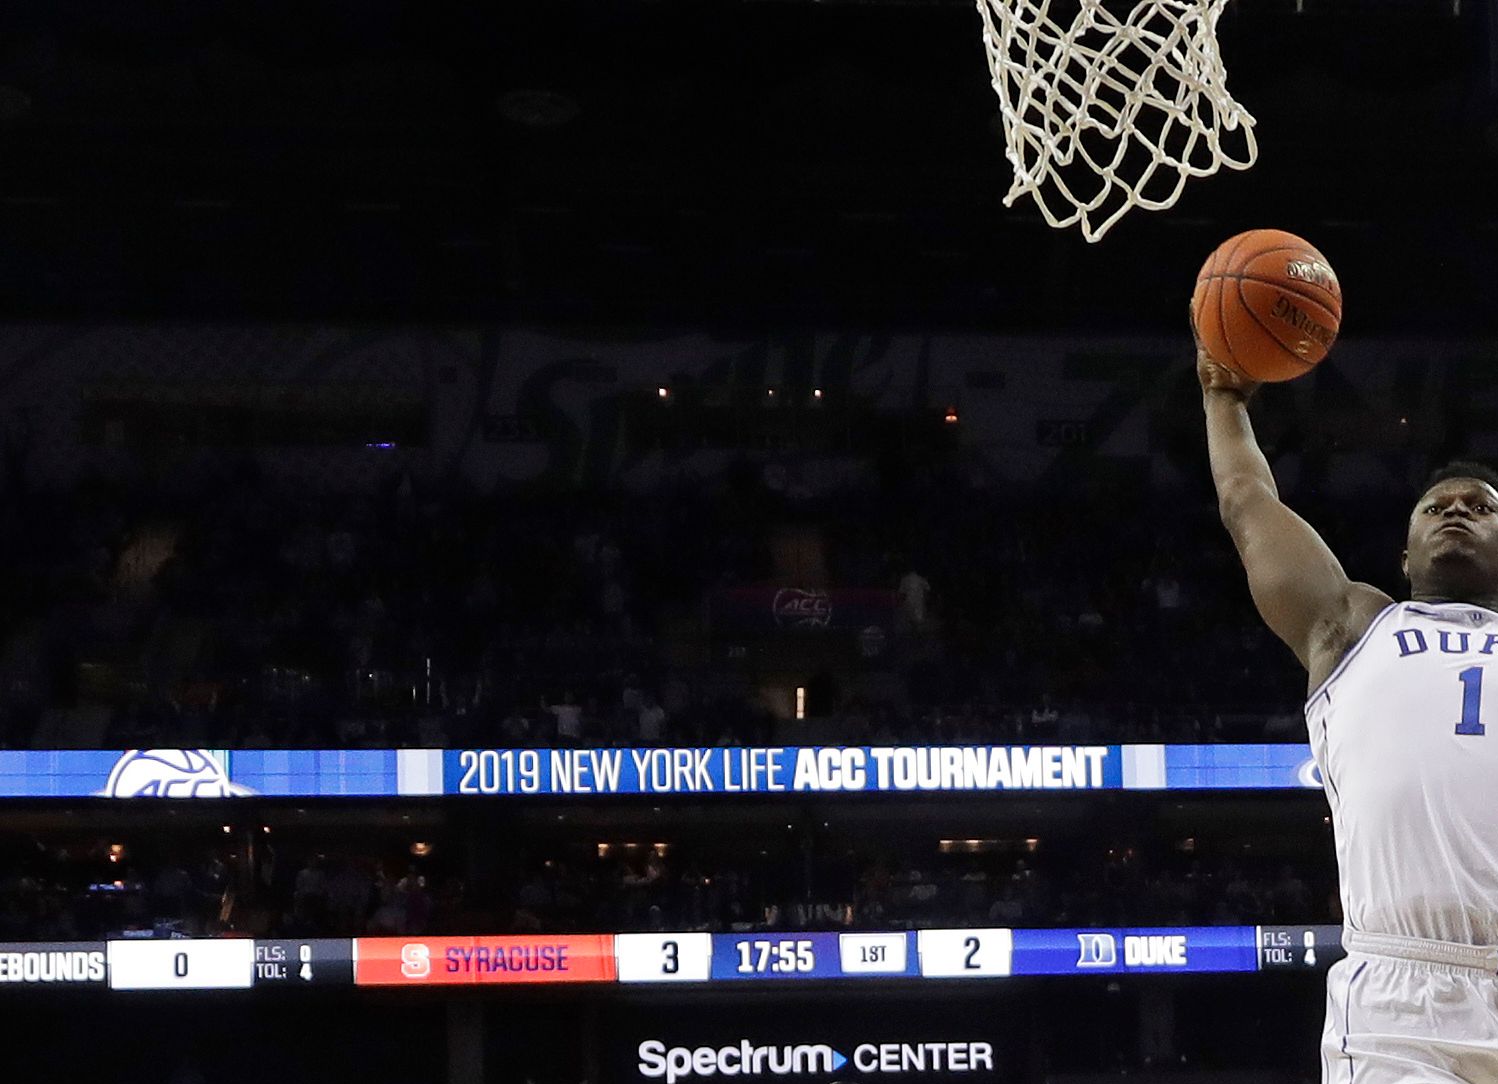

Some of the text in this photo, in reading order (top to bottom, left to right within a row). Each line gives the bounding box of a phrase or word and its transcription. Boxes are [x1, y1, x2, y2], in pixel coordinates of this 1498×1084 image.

[1454, 666, 1486, 736] 1
[459, 745, 1108, 793] 2019 NEW YORK LIFE ACC TOURNAMENT
[256, 944, 311, 962] FLS: 0
[860, 944, 887, 963] 1ST
[964, 936, 981, 970] 2
[1124, 935, 1188, 966] DUKE
[1263, 930, 1315, 948] FLS: 0
[174, 952, 188, 978] 0
[446, 944, 569, 974] SYRACUSE
[662, 942, 679, 975] 3
[736, 939, 815, 973] 17:55
[1264, 948, 1293, 963] TOL:
[256, 962, 313, 980] TOL: 4
[638, 1039, 993, 1084] Spectrum CENTER
